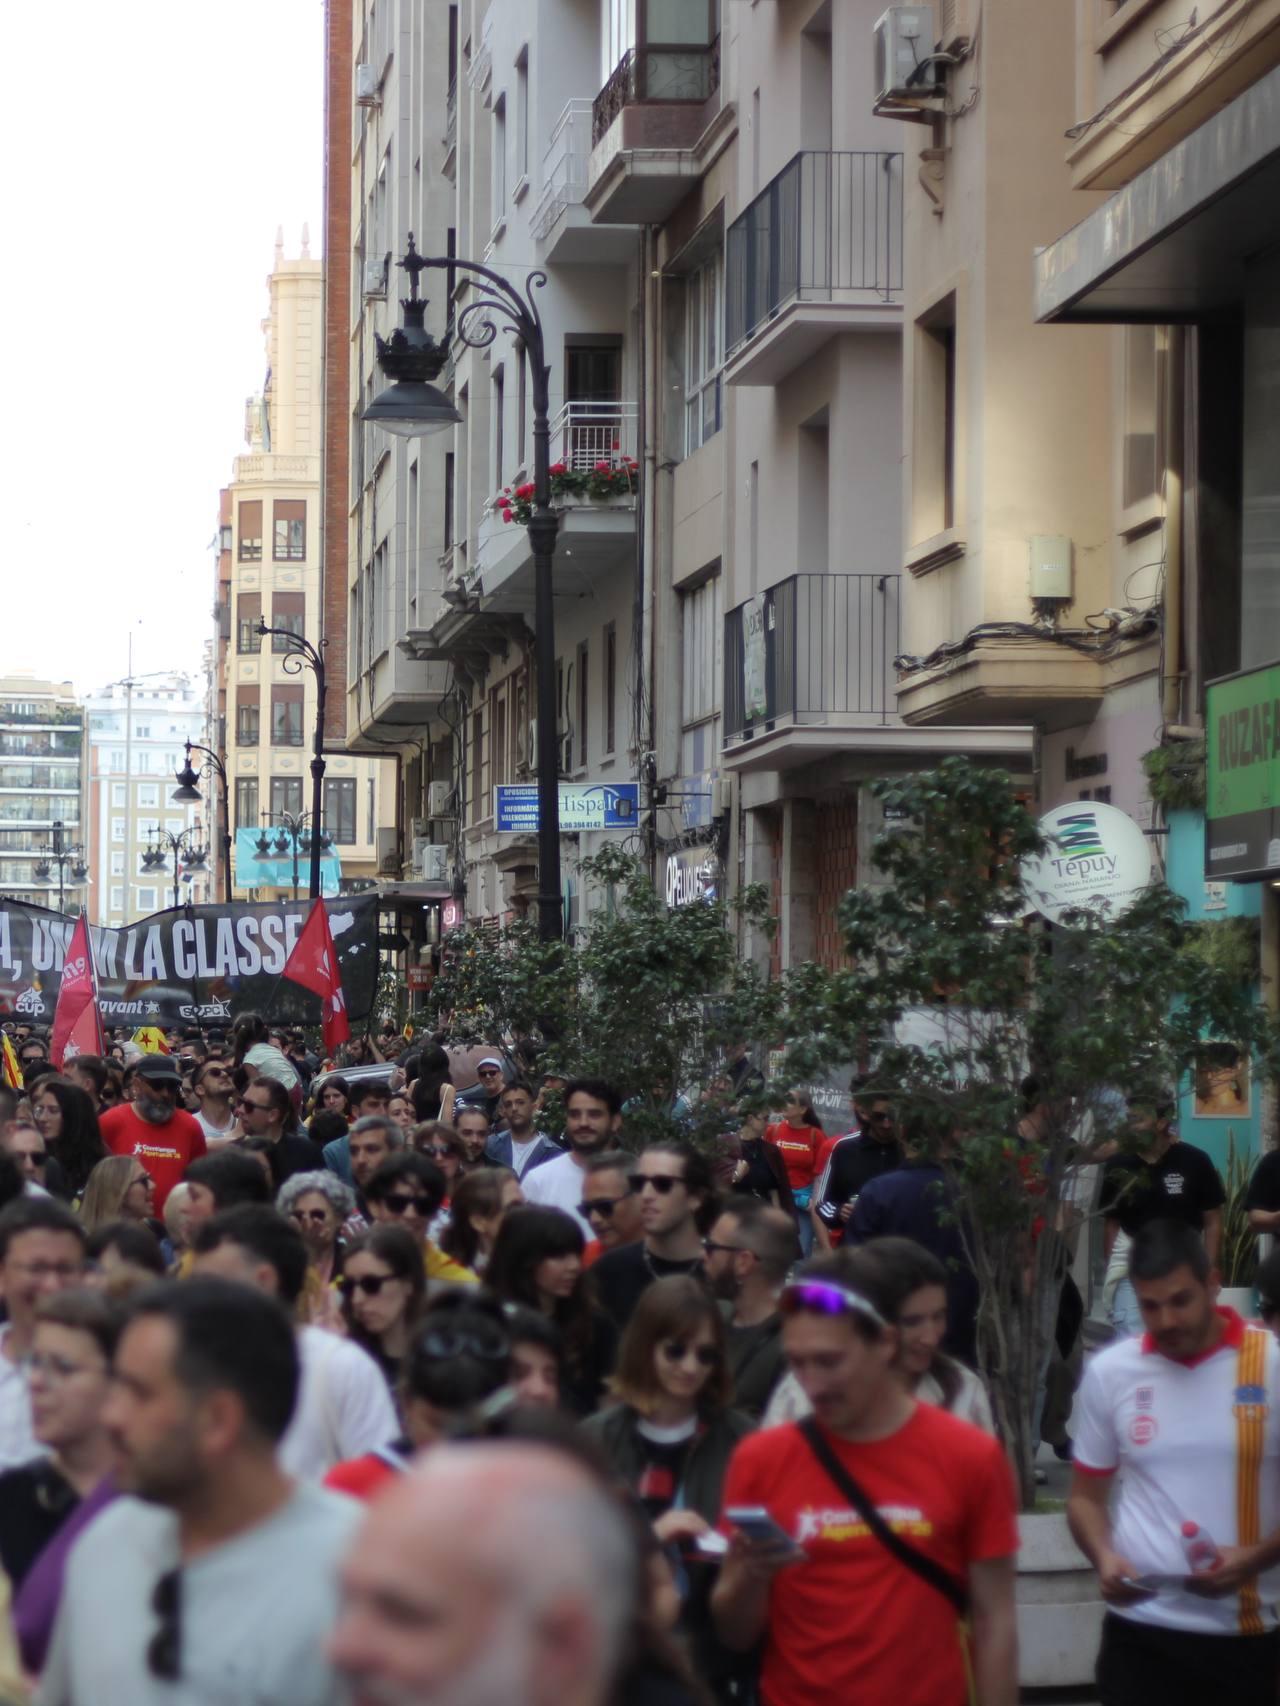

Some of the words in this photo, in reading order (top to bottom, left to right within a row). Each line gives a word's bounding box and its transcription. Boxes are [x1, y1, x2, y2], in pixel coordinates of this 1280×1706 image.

[503, 788, 539, 796] OPOSICIONE
[504, 804, 539, 813] INFORMÁTIC
[1051, 855, 1118, 878] Tepuy
[31, 918, 119, 979] UNM
[124, 924, 167, 981] LA
